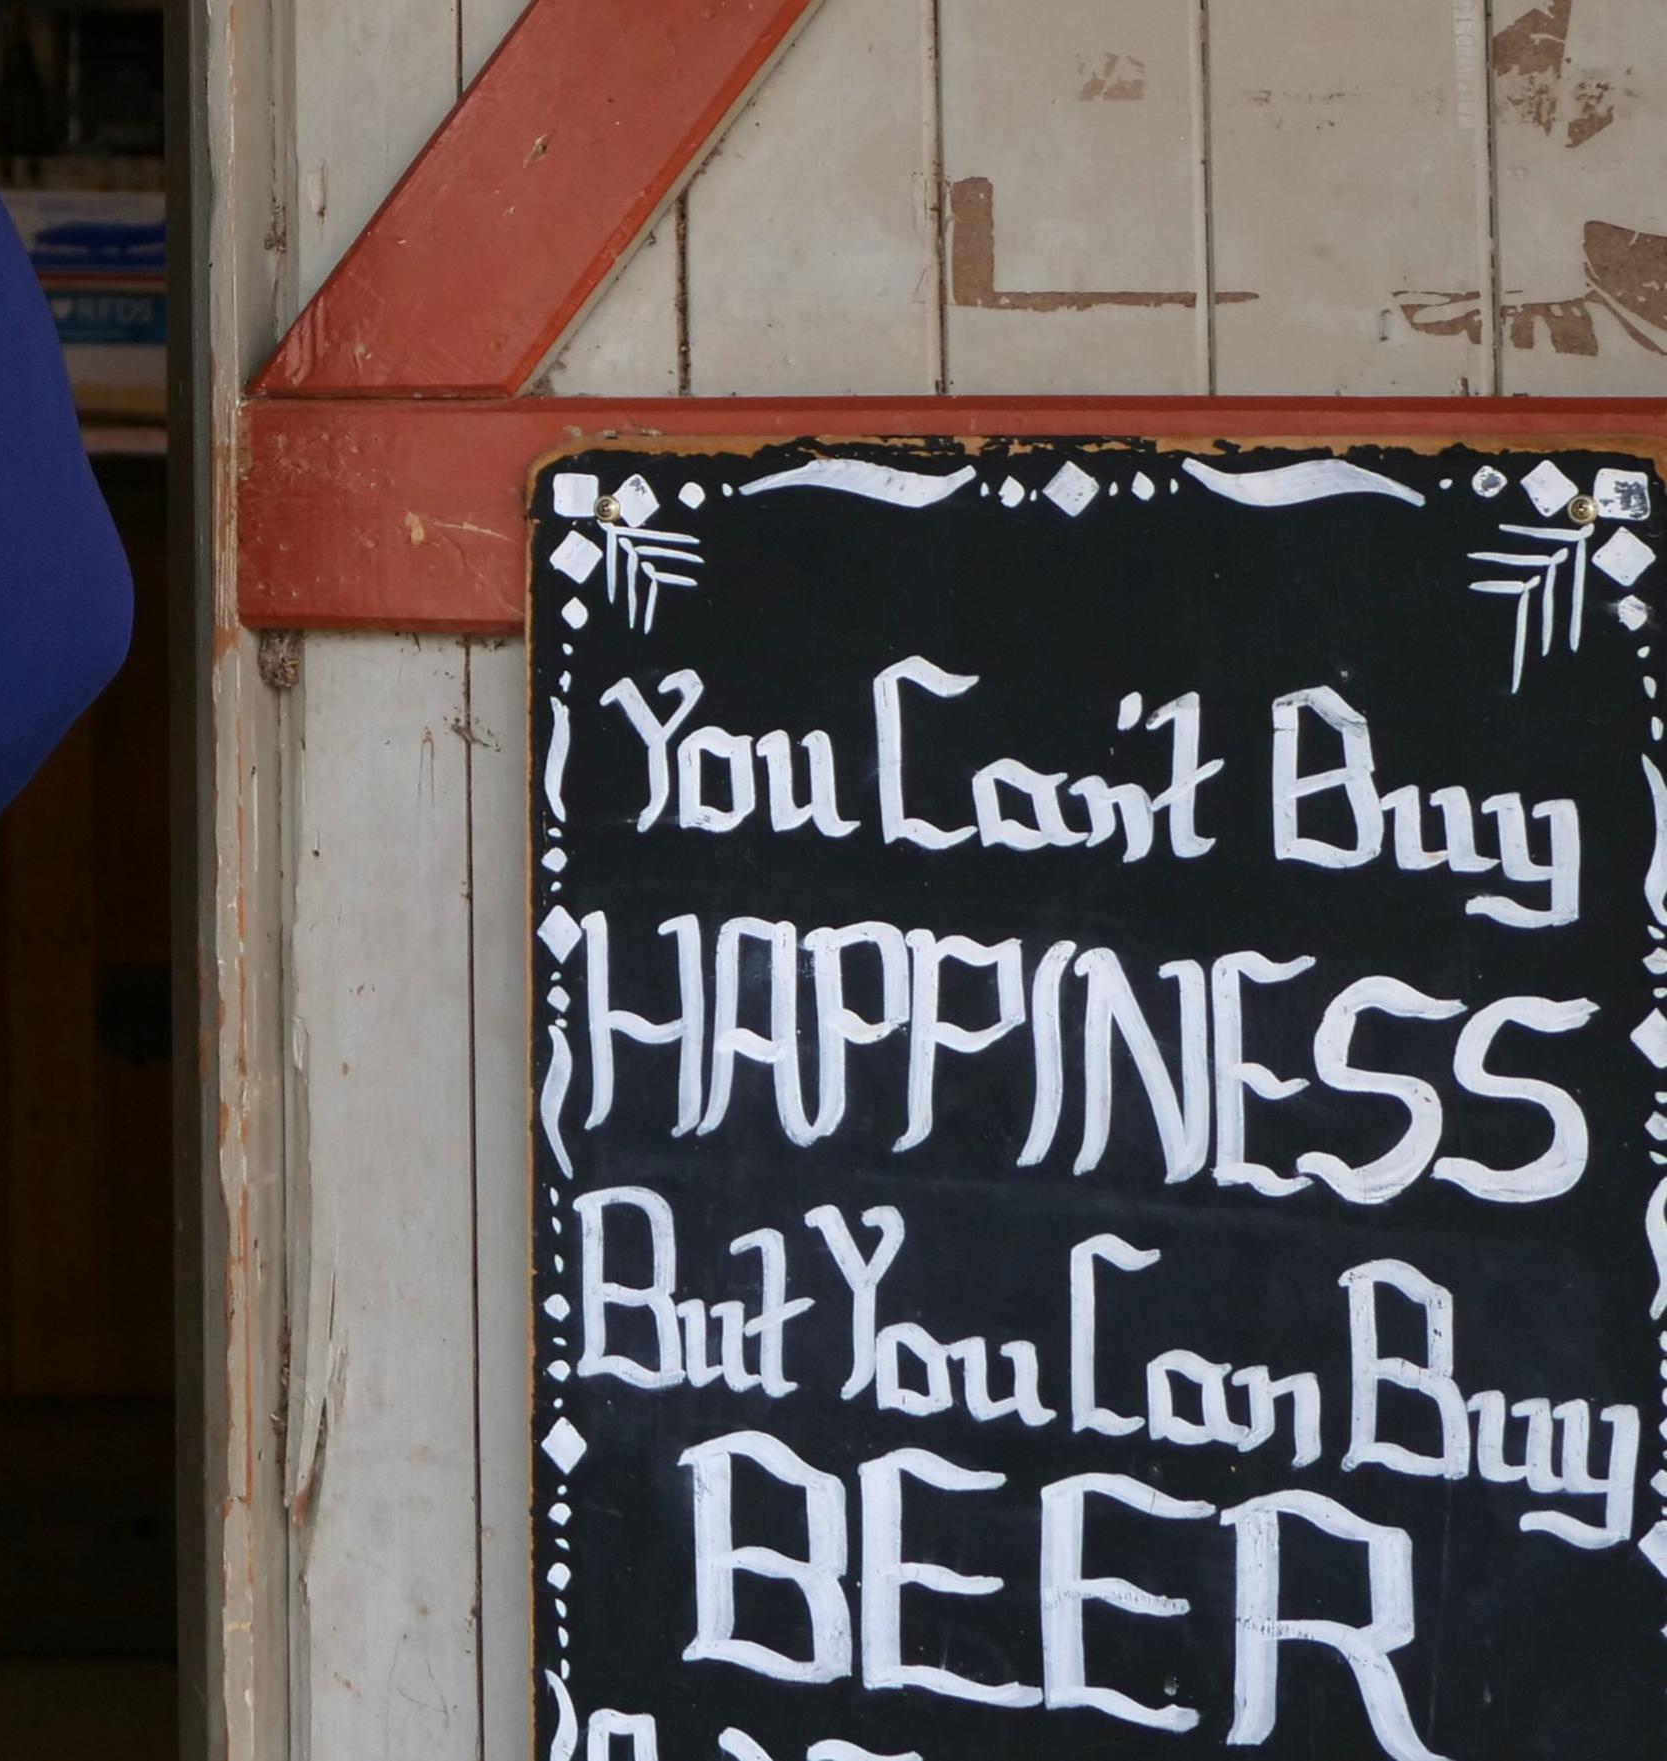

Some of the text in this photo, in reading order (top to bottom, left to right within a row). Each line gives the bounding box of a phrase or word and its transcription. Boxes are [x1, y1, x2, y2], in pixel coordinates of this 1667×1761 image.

[600, 655, 1580, 929] You Can't Buy
[582, 910, 1600, 1204] HAPPINESS
[574, 1186, 1640, 1549] But You Can Buy
[679, 1431, 1459, 1761] BEER
